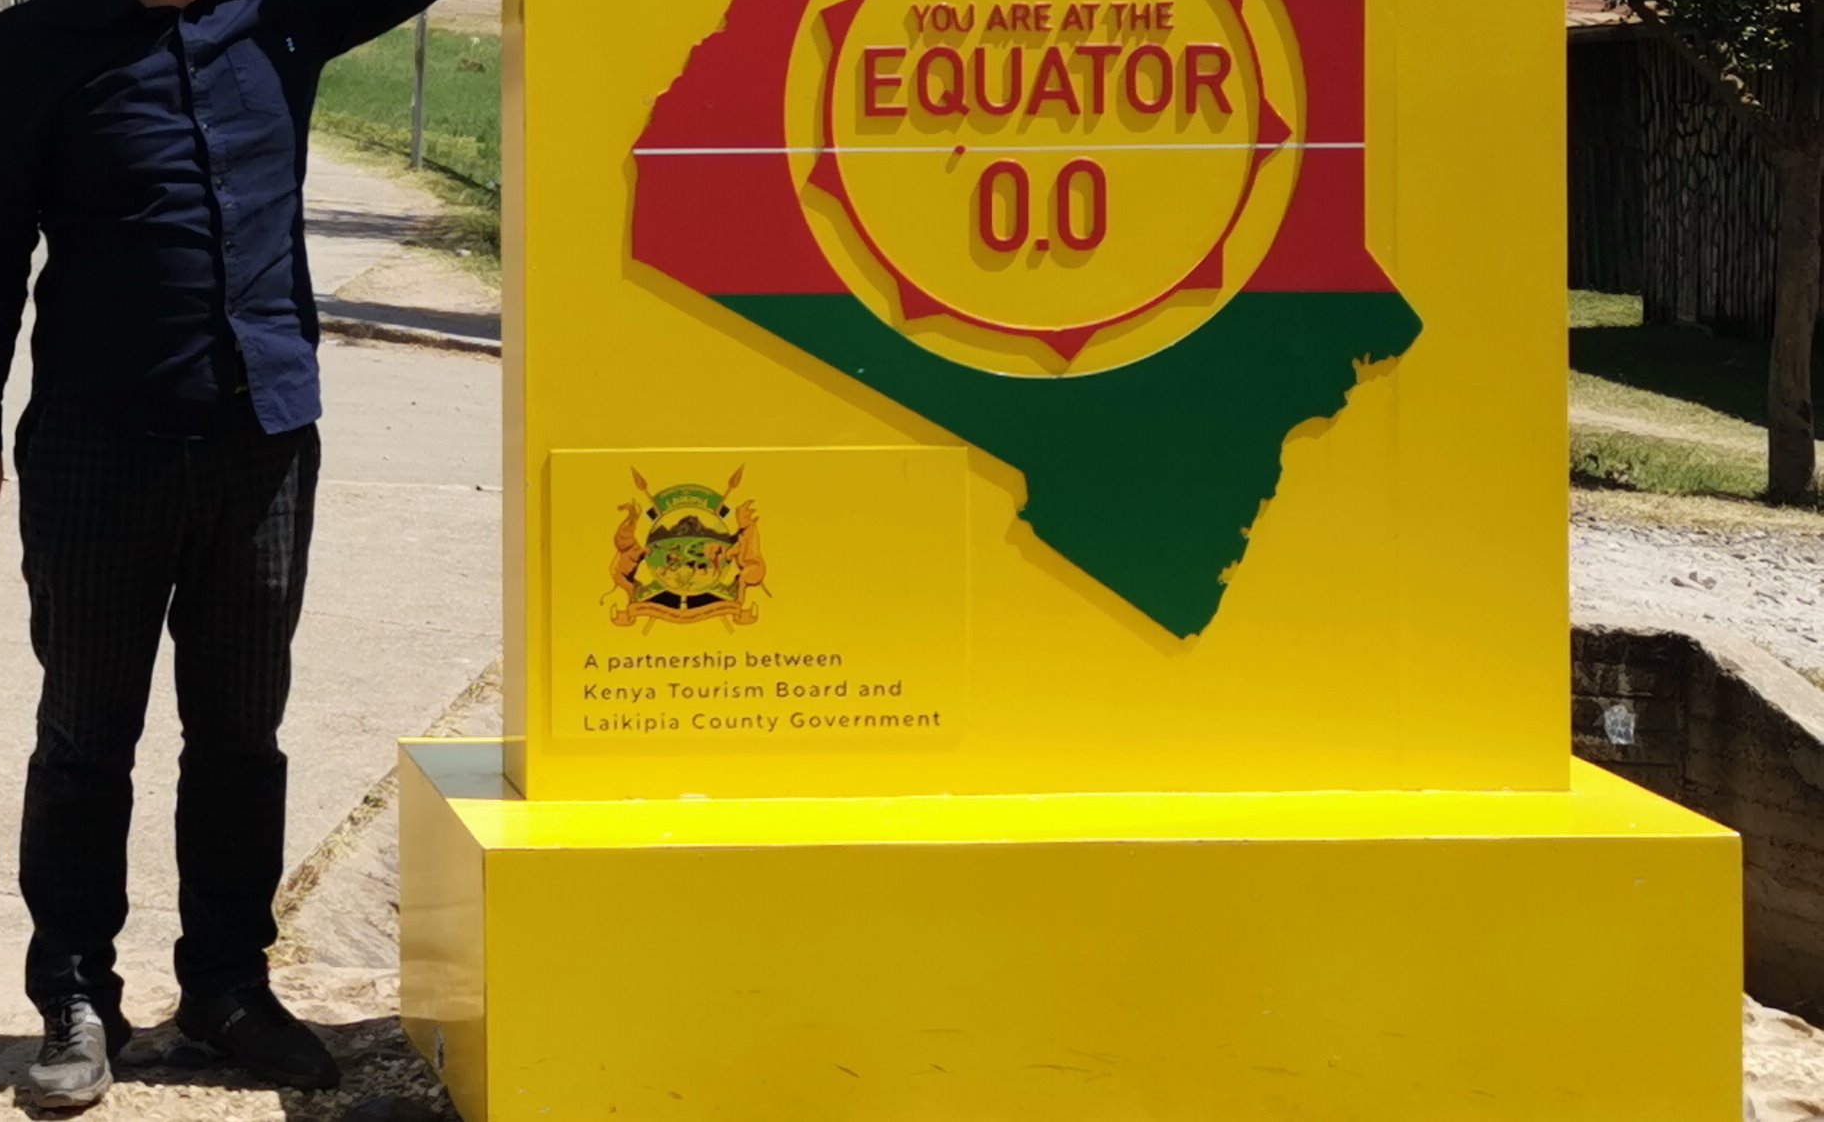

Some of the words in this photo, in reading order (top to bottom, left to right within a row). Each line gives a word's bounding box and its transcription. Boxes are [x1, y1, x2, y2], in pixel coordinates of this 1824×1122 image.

[910, 2, 975, 33] YOU
[985, 2, 1053, 32] ARE
[1061, 2, 1102, 31] AT
[1113, 0, 1175, 31] THE
[863, 43, 1234, 118] EQUATOR
[583, 653, 599, 670] A
[607, 650, 738, 671] partnership
[745, 650, 843, 668] between
[583, 683, 657, 703] Kenya
[668, 682, 765, 699] Tourism
[775, 681, 848, 699] Board
[858, 680, 903, 698] and
[583, 714, 680, 734] Laikipia
[692, 712, 779, 732] County
[789, 710, 942, 730] Government
